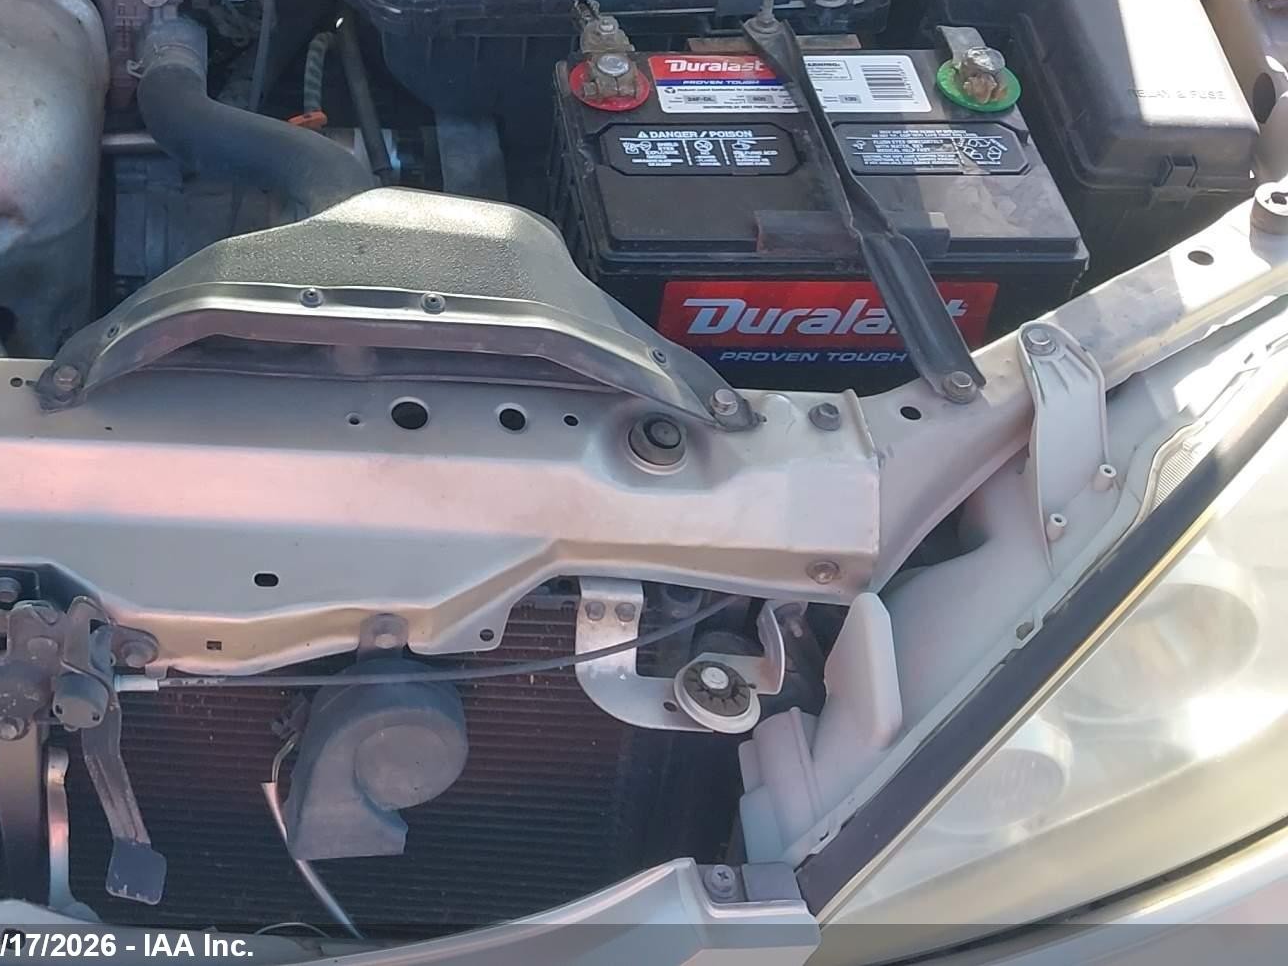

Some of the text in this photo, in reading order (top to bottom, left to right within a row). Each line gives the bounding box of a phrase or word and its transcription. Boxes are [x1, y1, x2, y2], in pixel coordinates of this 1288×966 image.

[664, 59, 765, 72] Duralast
[708, 130, 753, 138] POISON
[683, 298, 967, 335] Duralat
[720, 352, 909, 362] PROVEN TOUGH
